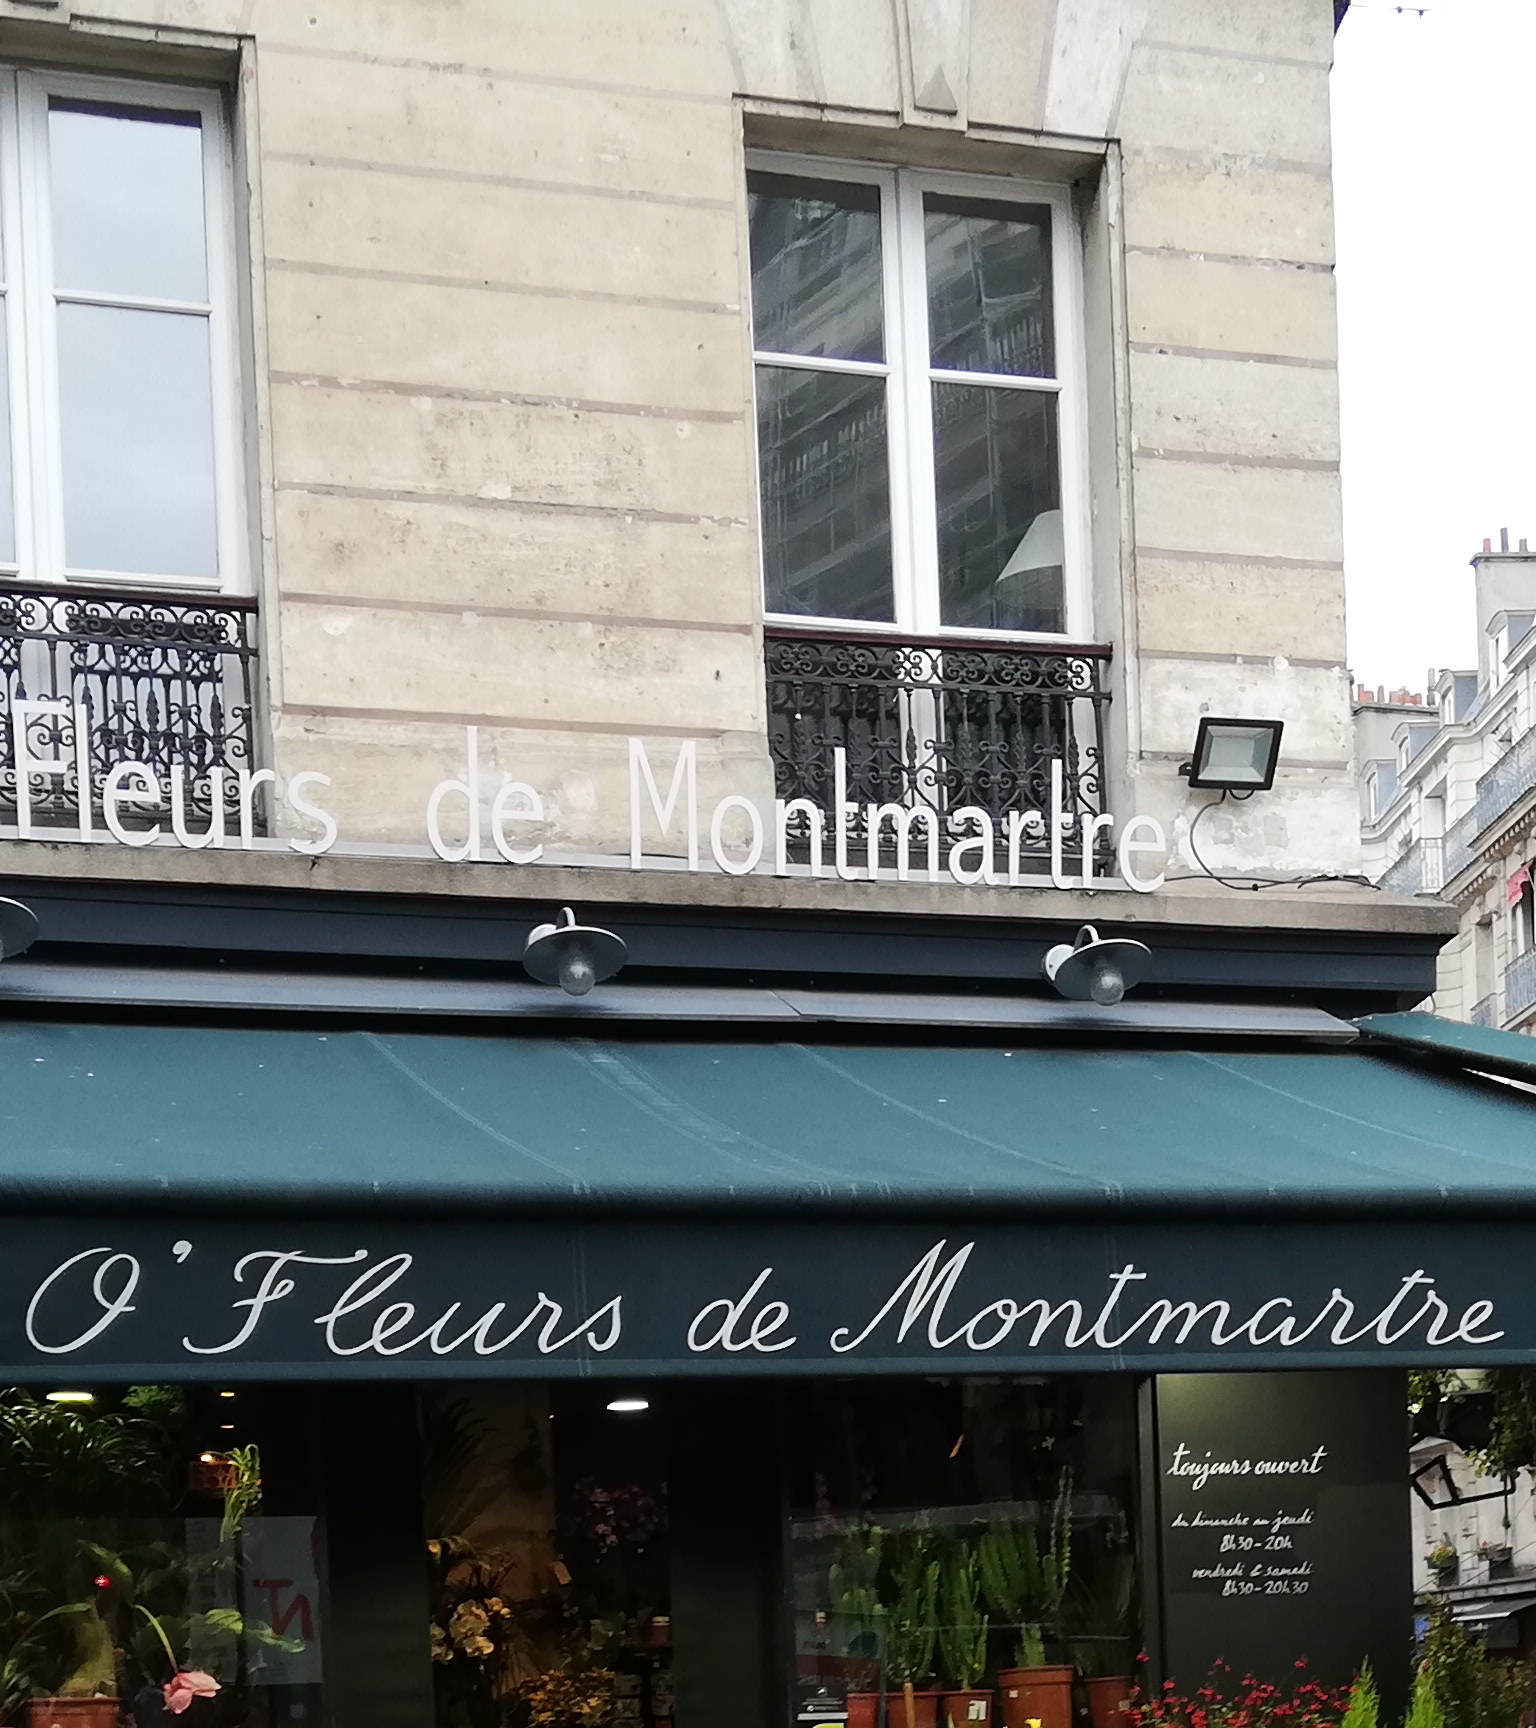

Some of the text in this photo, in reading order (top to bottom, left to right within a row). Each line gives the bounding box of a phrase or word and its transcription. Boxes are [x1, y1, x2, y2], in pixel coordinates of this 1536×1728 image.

[426, 725, 543, 862] de
[628, 731, 1166, 893] Montmartre
[687, 1268, 798, 1353] de
[831, 1239, 1506, 1353] Montmartre
[1167, 1443, 1328, 1490] toujours ouvert
[1272, 1508, 1315, 1533] jeudi
[1192, 1562, 1245, 1578] vendredi
[1264, 1561, 1314, 1577] samedi
